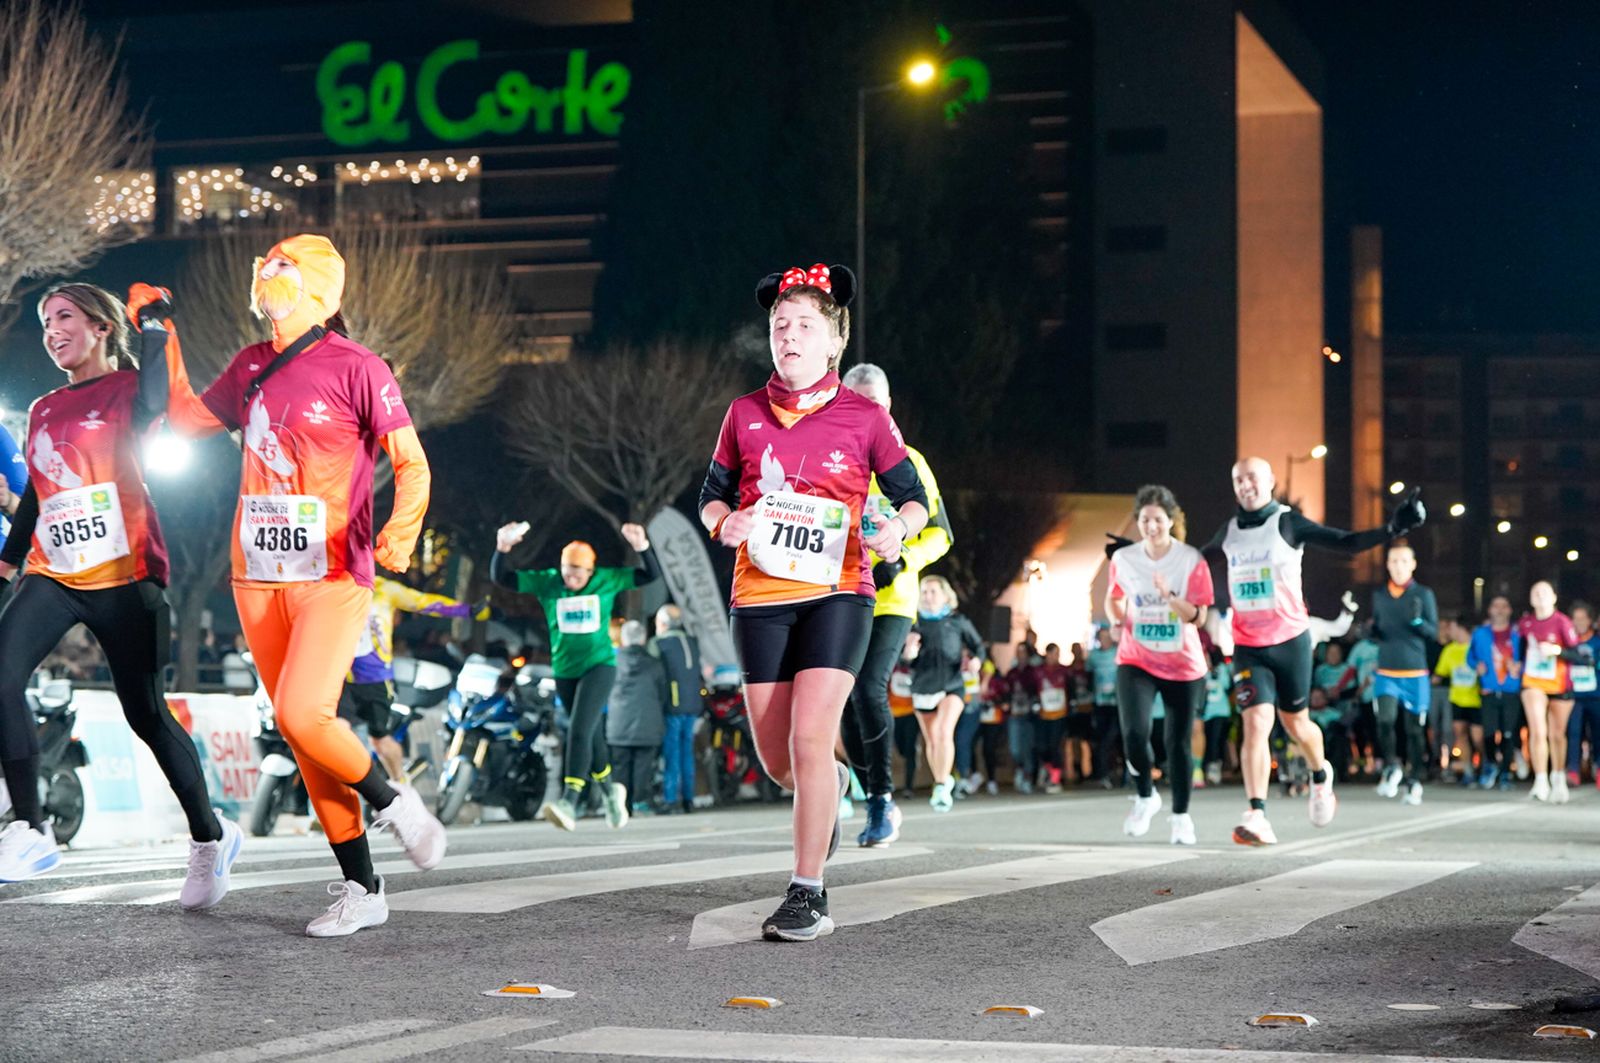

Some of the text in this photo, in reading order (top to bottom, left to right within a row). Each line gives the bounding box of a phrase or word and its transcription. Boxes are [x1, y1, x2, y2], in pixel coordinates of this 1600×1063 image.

[315, 39, 631, 145] El Corte
[763, 508, 782, 520] SAN
[775, 501, 804, 512] NOCHE
[805, 505, 816, 514] DE
[49, 516, 107, 548] 3855
[254, 527, 308, 551] 4386
[770, 522, 825, 554] 7103
[1141, 624, 1176, 637] 12703
[210, 731, 250, 762] SAN
